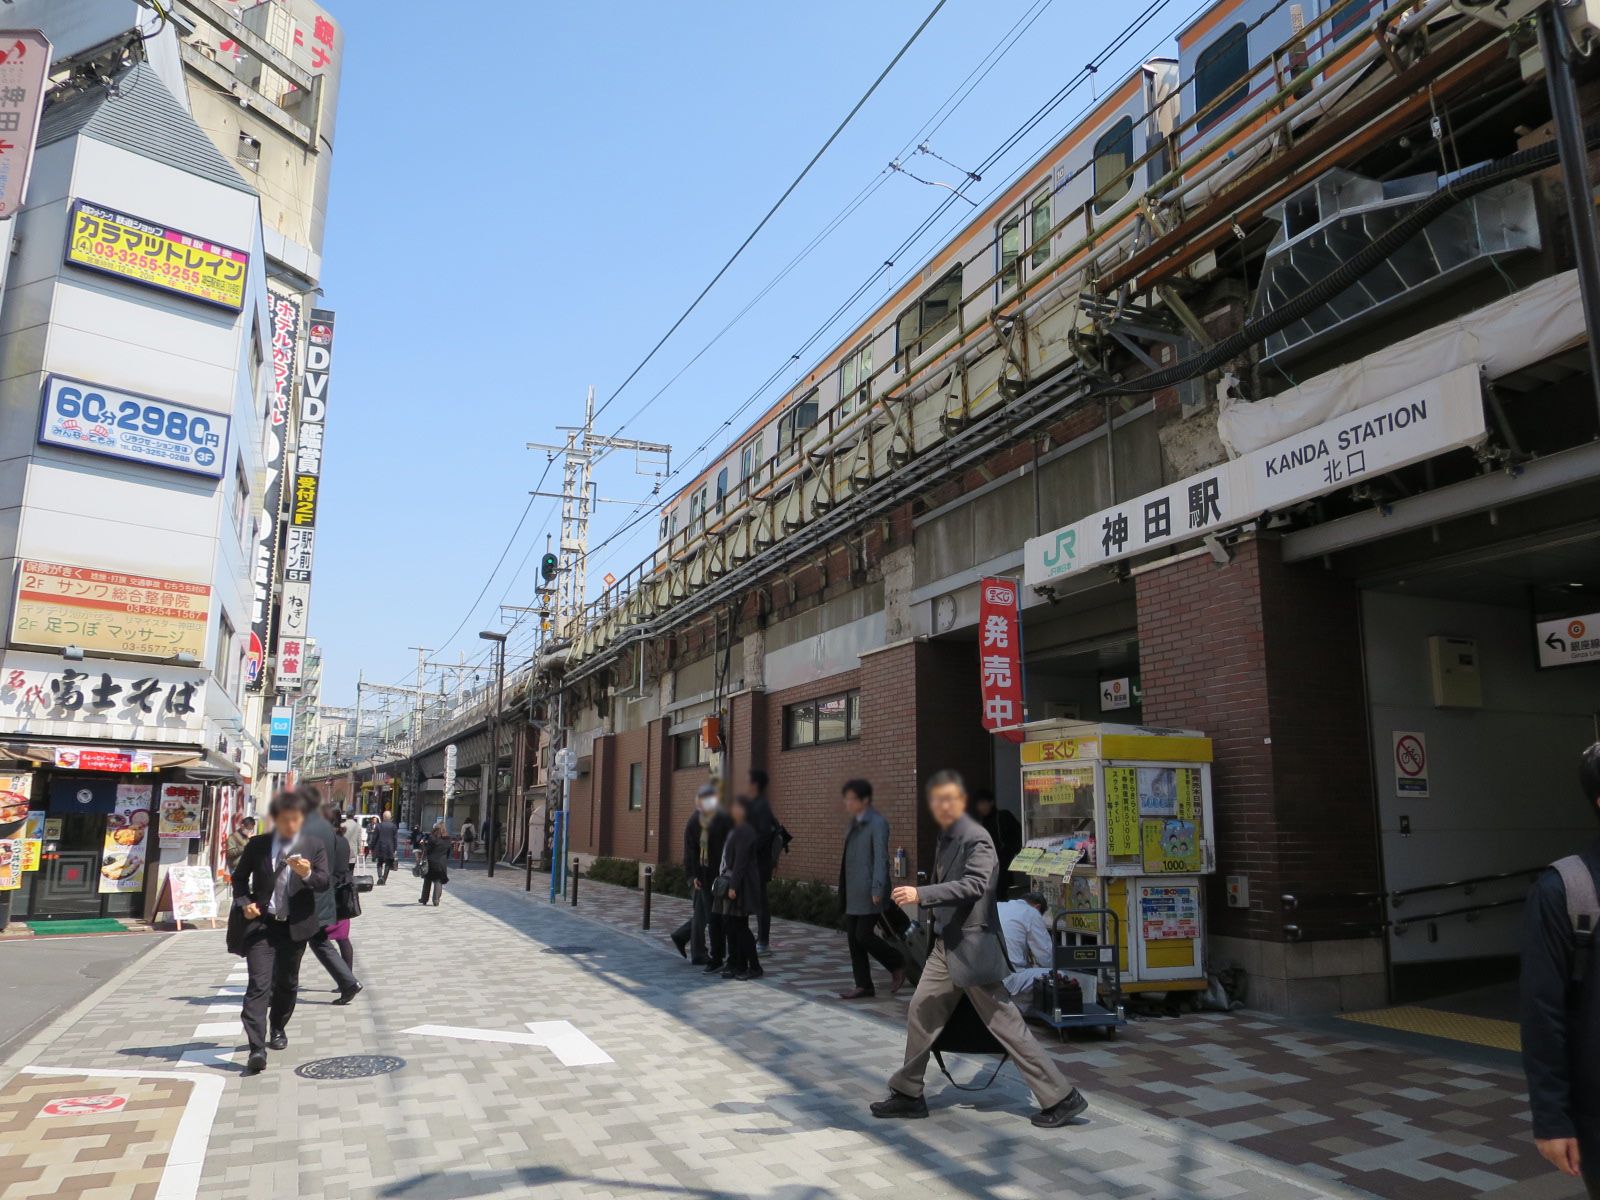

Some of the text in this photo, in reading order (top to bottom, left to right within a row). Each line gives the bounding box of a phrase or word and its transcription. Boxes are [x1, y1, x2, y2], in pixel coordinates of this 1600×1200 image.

[78, 216, 242, 281] カラマツトレイン
[94, 241, 199, 284] 03-3255-3255
[298, 345, 330, 474] DVD鑑賞
[196, 451, 213, 462] 3F
[1266, 400, 1428, 478] KANDA STATION
[1324, 450, 1367, 485] 北口
[295, 476, 316, 525] 受付2F
[1102, 478, 1222, 557] 神田駅
[289, 530, 300, 568] コイン
[300, 531, 312, 569] 駅前
[1043, 530, 1077, 567] JR
[25, 562, 83, 580] 保険がきく
[25, 576, 45, 589] 2F
[289, 571, 308, 580] 5F
[126, 604, 202, 619] 03-3254-1567
[288, 595, 303, 628] ねぎし
[989, 590, 1011, 602] 宝くじ
[18, 617, 185, 644] 2F 足つぼ マッサージ
[282, 641, 300, 674] 麻雀
[983, 615, 1013, 729] 発売中
[51, 668, 205, 715] 富士そば
[1042, 741, 1075, 760] 宝くじ
